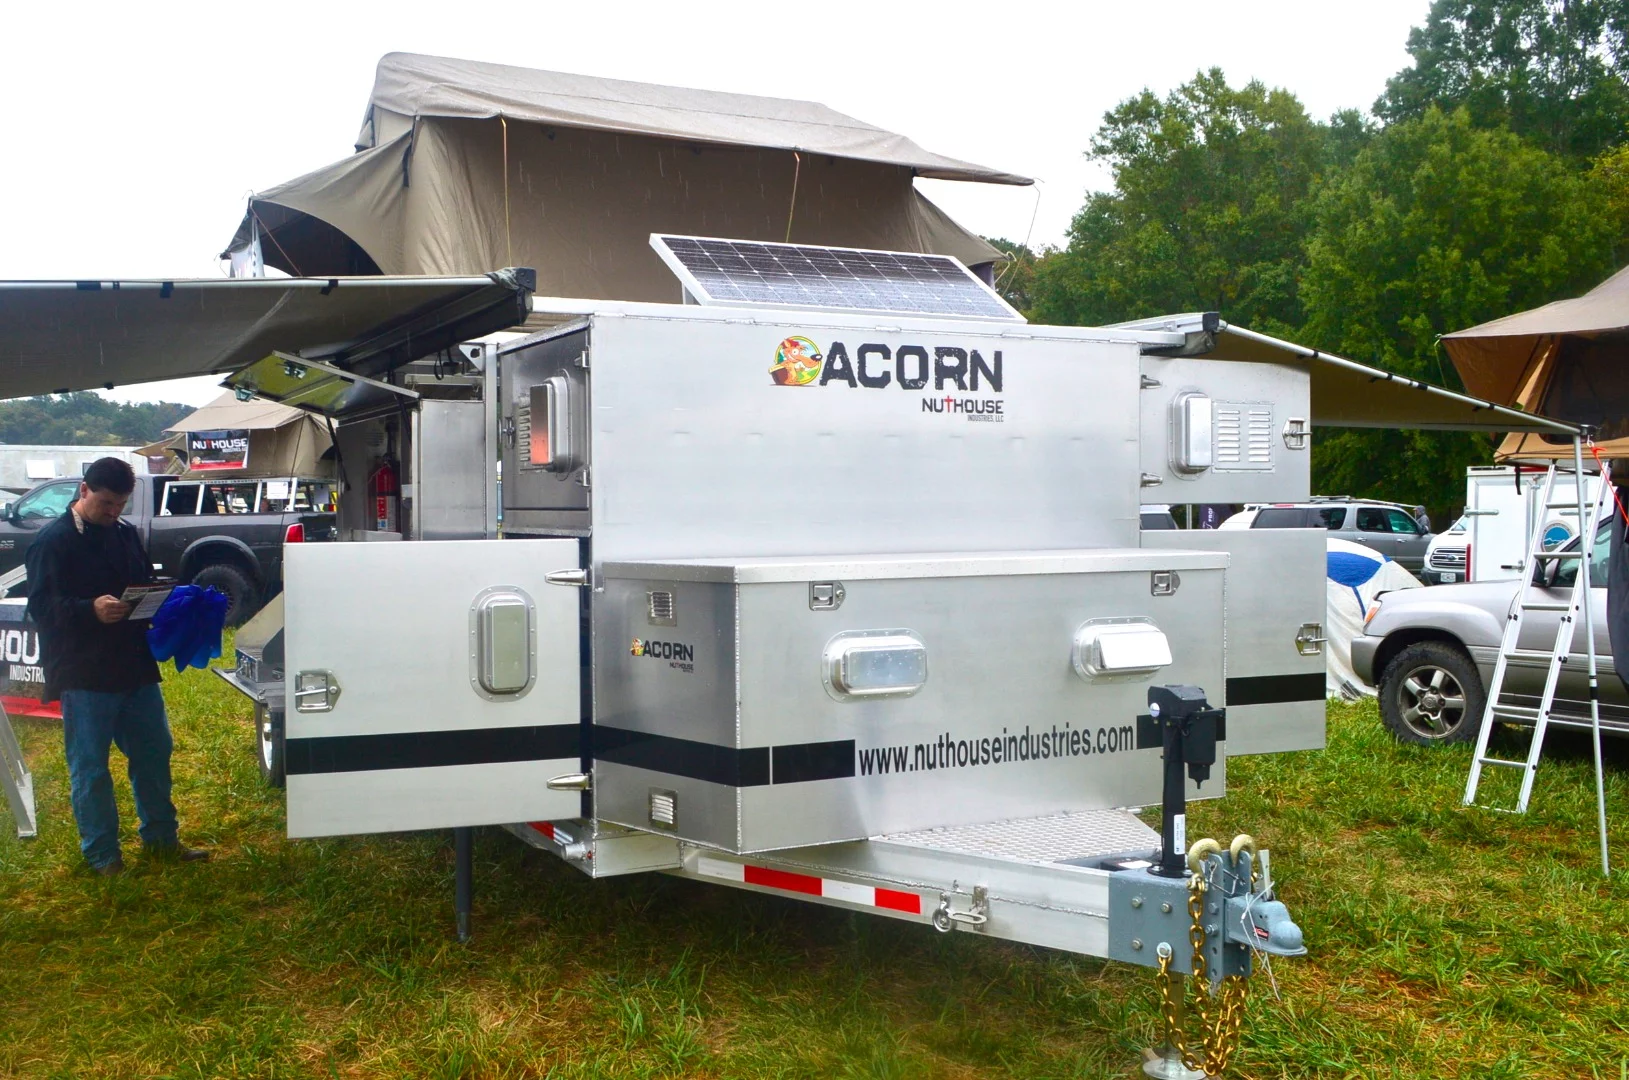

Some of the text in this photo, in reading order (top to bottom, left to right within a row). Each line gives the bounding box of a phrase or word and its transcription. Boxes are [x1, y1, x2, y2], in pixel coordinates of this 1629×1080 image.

[819, 341, 1003, 392] ACORN
[922, 395, 1004, 414] NUTHOUSE
[995, 415, 1004, 423] LLC
[192, 438, 248, 449] NUTHOUSE
[642, 640, 694, 662] ACORN
[859, 722, 1134, 776] www.nuthouseindustries.com
